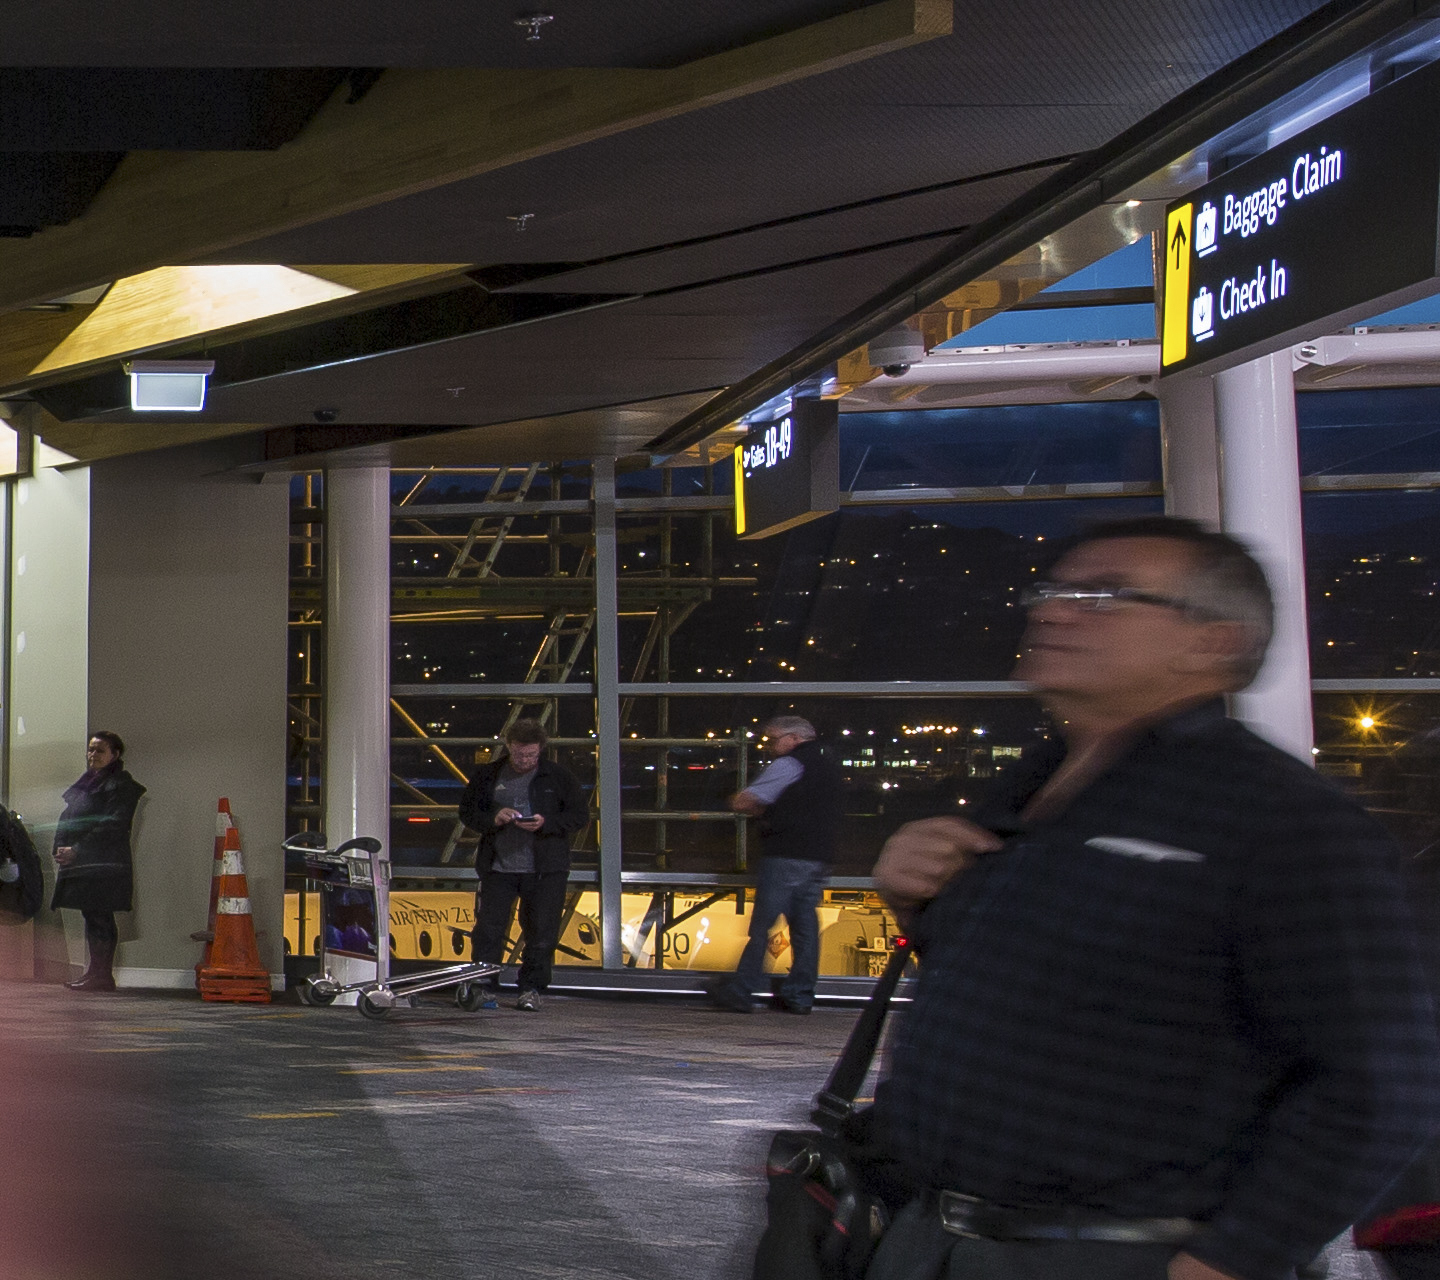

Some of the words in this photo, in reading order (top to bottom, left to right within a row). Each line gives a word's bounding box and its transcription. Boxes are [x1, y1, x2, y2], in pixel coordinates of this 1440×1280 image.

[1223, 177, 1287, 238] Baggage
[1292, 146, 1342, 200] Claim
[1220, 265, 1266, 320] Check
[1270, 259, 1286, 300] In
